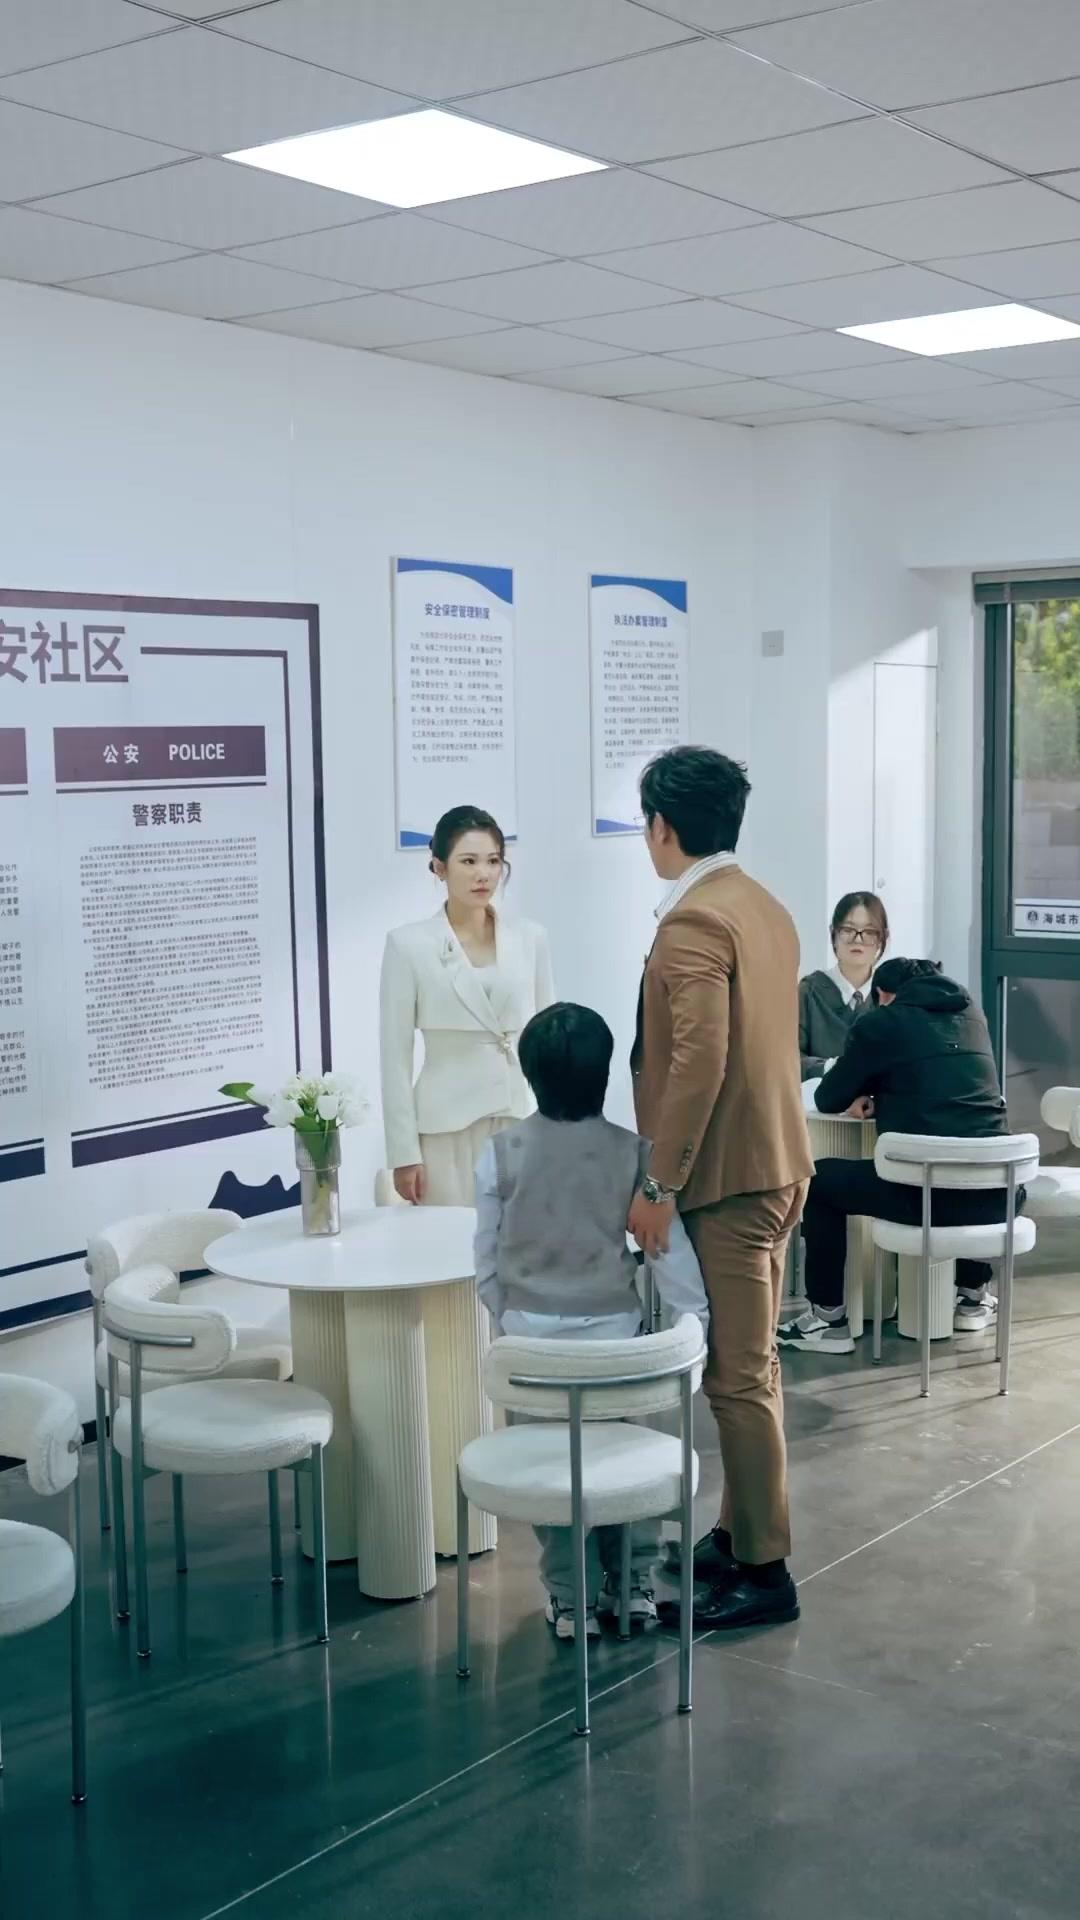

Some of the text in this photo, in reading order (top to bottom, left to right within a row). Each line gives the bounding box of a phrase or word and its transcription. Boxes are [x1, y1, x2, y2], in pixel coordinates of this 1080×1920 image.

[103, 743, 226, 764] 公安 POLICE
[132, 801, 202, 827] 警察职责
[1042, 911, 1079, 925] 海城市
